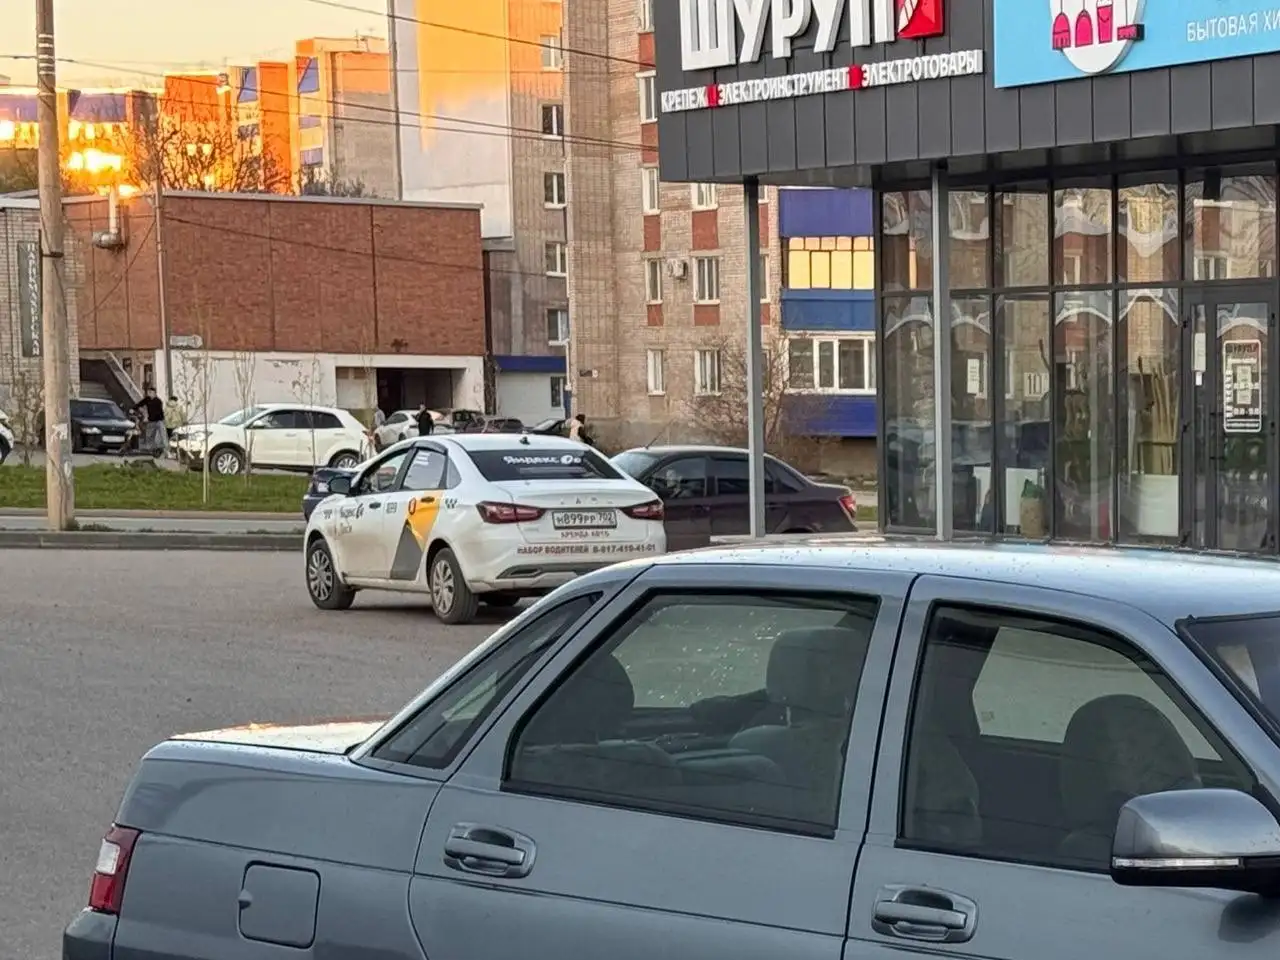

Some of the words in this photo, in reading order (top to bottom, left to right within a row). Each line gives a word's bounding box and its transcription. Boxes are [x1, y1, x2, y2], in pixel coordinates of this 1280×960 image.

[681, 0, 896, 71] ШУРУП
[1187, 12, 1258, 42] БЫТОВАЯ
[661, 85, 709, 113] КРЕПЕЖ
[718, 66, 850, 106] ЭЛЕКТРОИНСТРУМЕНТ
[861, 49, 983, 87] ЭЛЕКТРОТОВАРЫ
